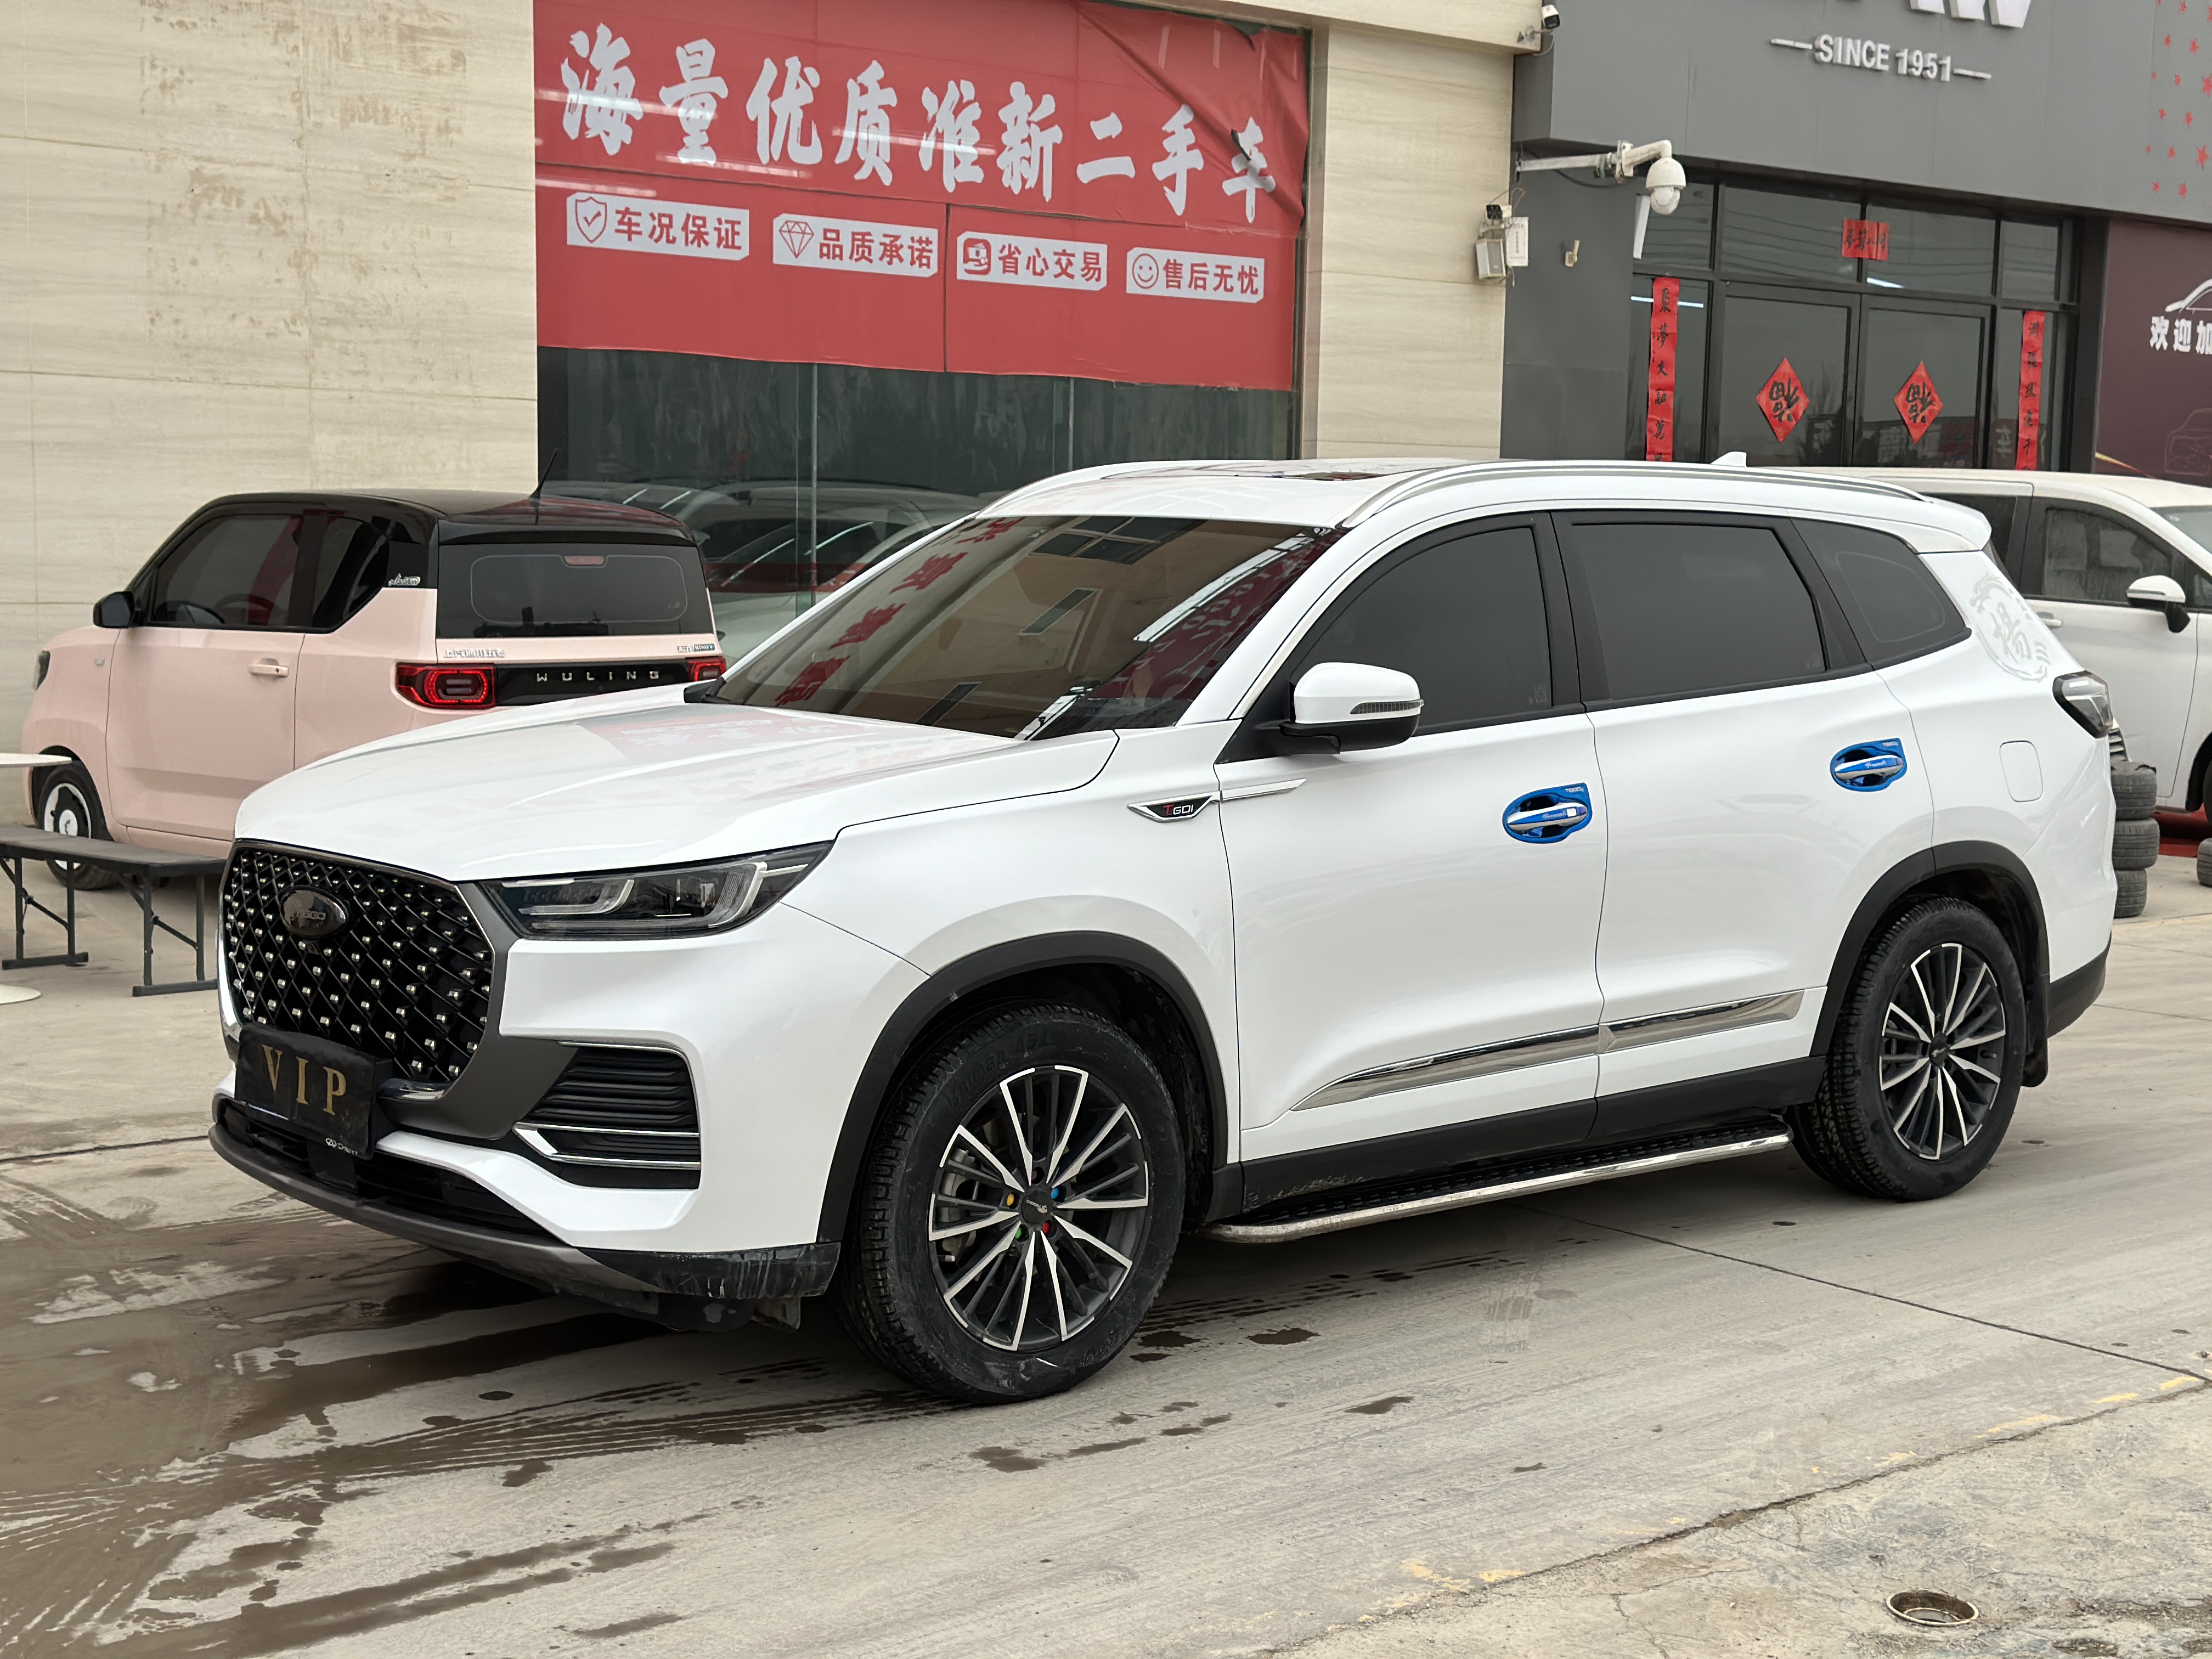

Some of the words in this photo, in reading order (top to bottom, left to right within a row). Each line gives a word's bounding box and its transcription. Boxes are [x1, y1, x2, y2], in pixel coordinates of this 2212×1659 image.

[1814, 33, 1891, 72] SINCE
[1895, 48, 1951, 82] 1951
[614, 206, 742, 251] 车况保证
[818, 227, 933, 269] 品质承诺
[998, 244, 1102, 283] 省心交易
[1163, 258, 1259, 295] 售后无忧
[536, 670, 659, 682] WULING
[261, 1044, 347, 1116] VIP
